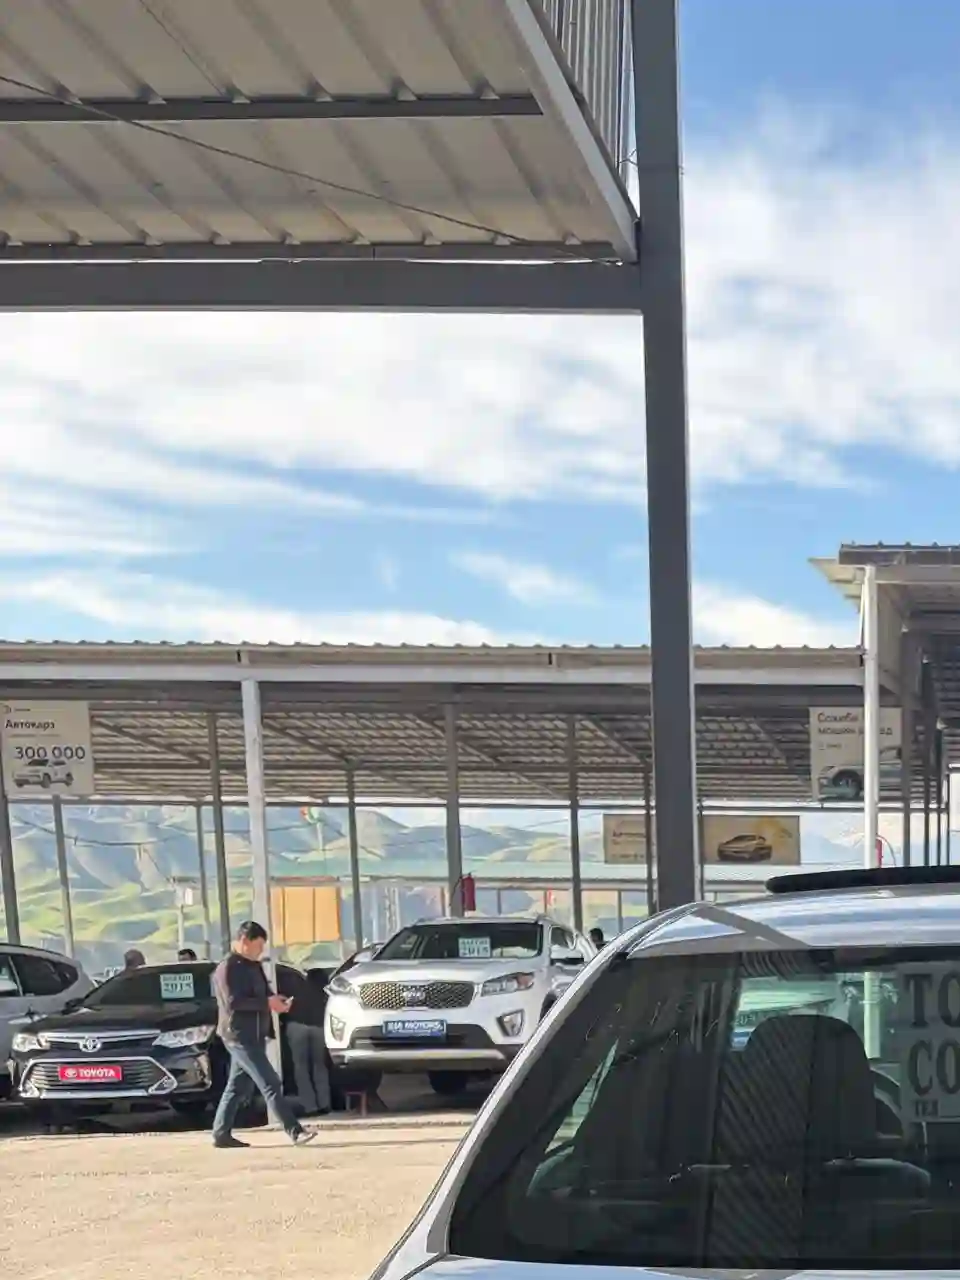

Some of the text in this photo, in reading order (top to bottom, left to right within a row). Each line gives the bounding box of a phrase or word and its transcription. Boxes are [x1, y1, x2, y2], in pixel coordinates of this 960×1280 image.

[14, 746, 86, 760] 300 000
[79, 1068, 116, 1078] TOYOTA
